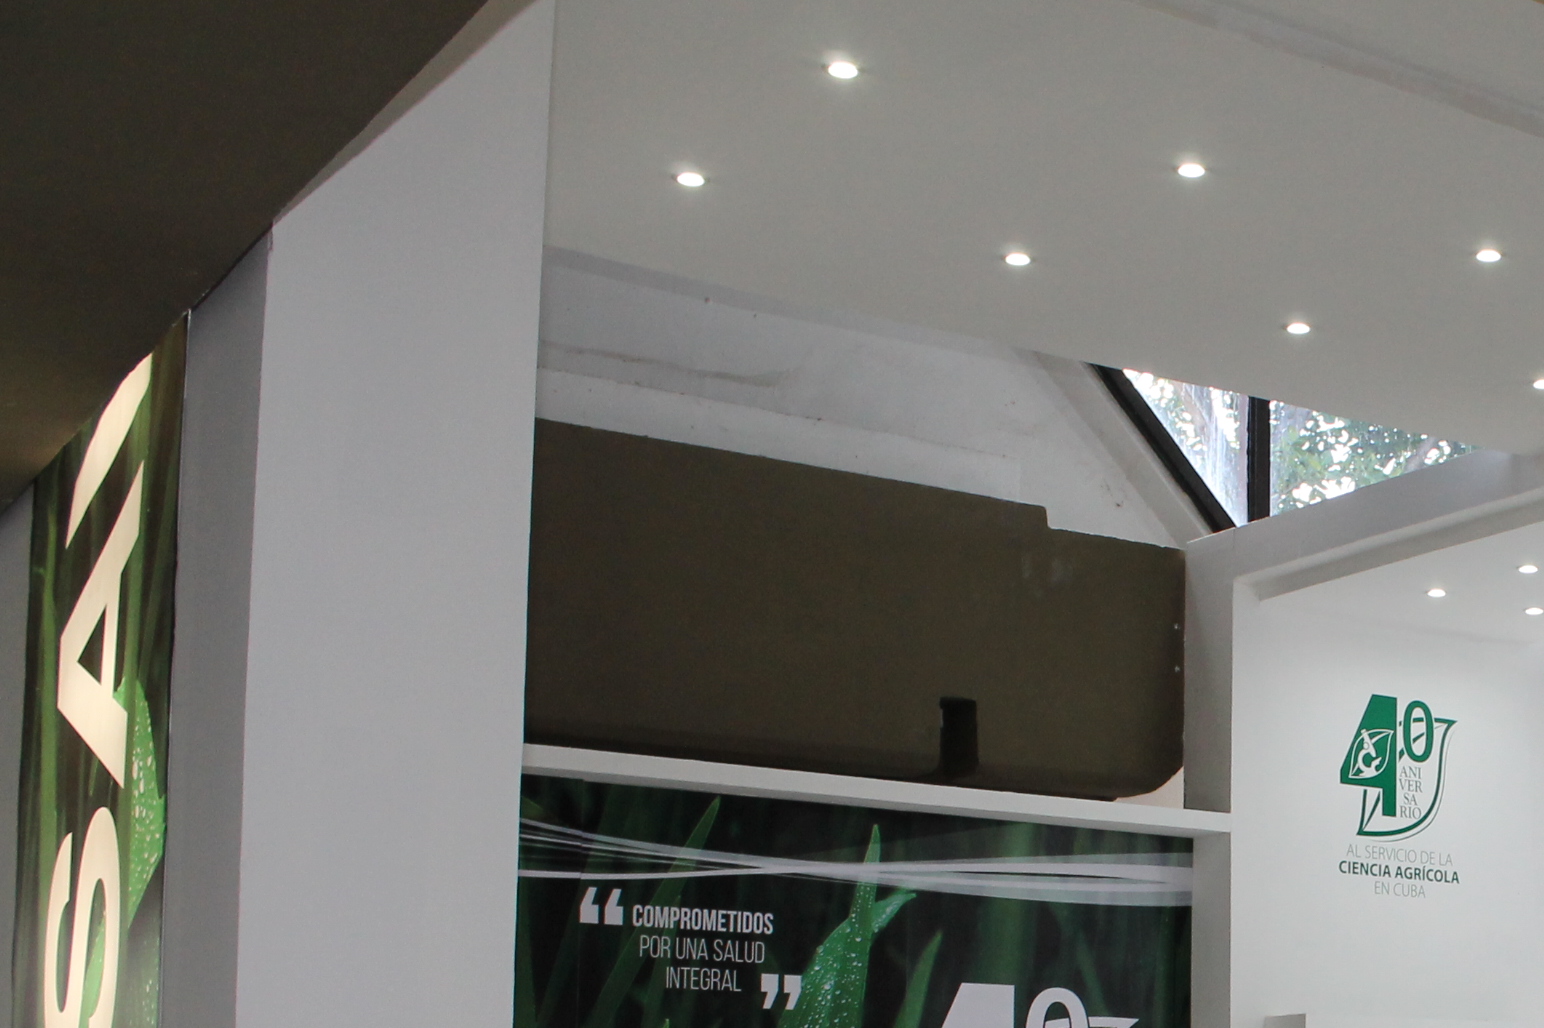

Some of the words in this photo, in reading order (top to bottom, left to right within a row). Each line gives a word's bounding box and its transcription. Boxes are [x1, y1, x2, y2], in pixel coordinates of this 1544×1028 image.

[1340, 693, 1434, 818] 40
[1400, 766, 1422, 780] ANI
[1399, 778, 1423, 793] VER
[1403, 793, 1418, 806] SA
[1400, 806, 1422, 820] RIO
[1346, 844, 1361, 858] AL
[1365, 845, 1417, 863] SERVICIO
[1420, 851, 1435, 865] DE
[1439, 853, 1453, 867] LA
[1339, 861, 1391, 878] CIENCIA
[1395, 863, 1460, 884] AGRÍCOLA
[1374, 881, 1390, 895] EN
[1393, 883, 1426, 898] CUBA
[632, 905, 774, 935] COMPROMETIDOS
[639, 935, 671, 958] POR
[675, 937, 708, 961] UNA
[713, 939, 765, 963] SALUD
[665, 966, 742, 992] INTEGRAL
